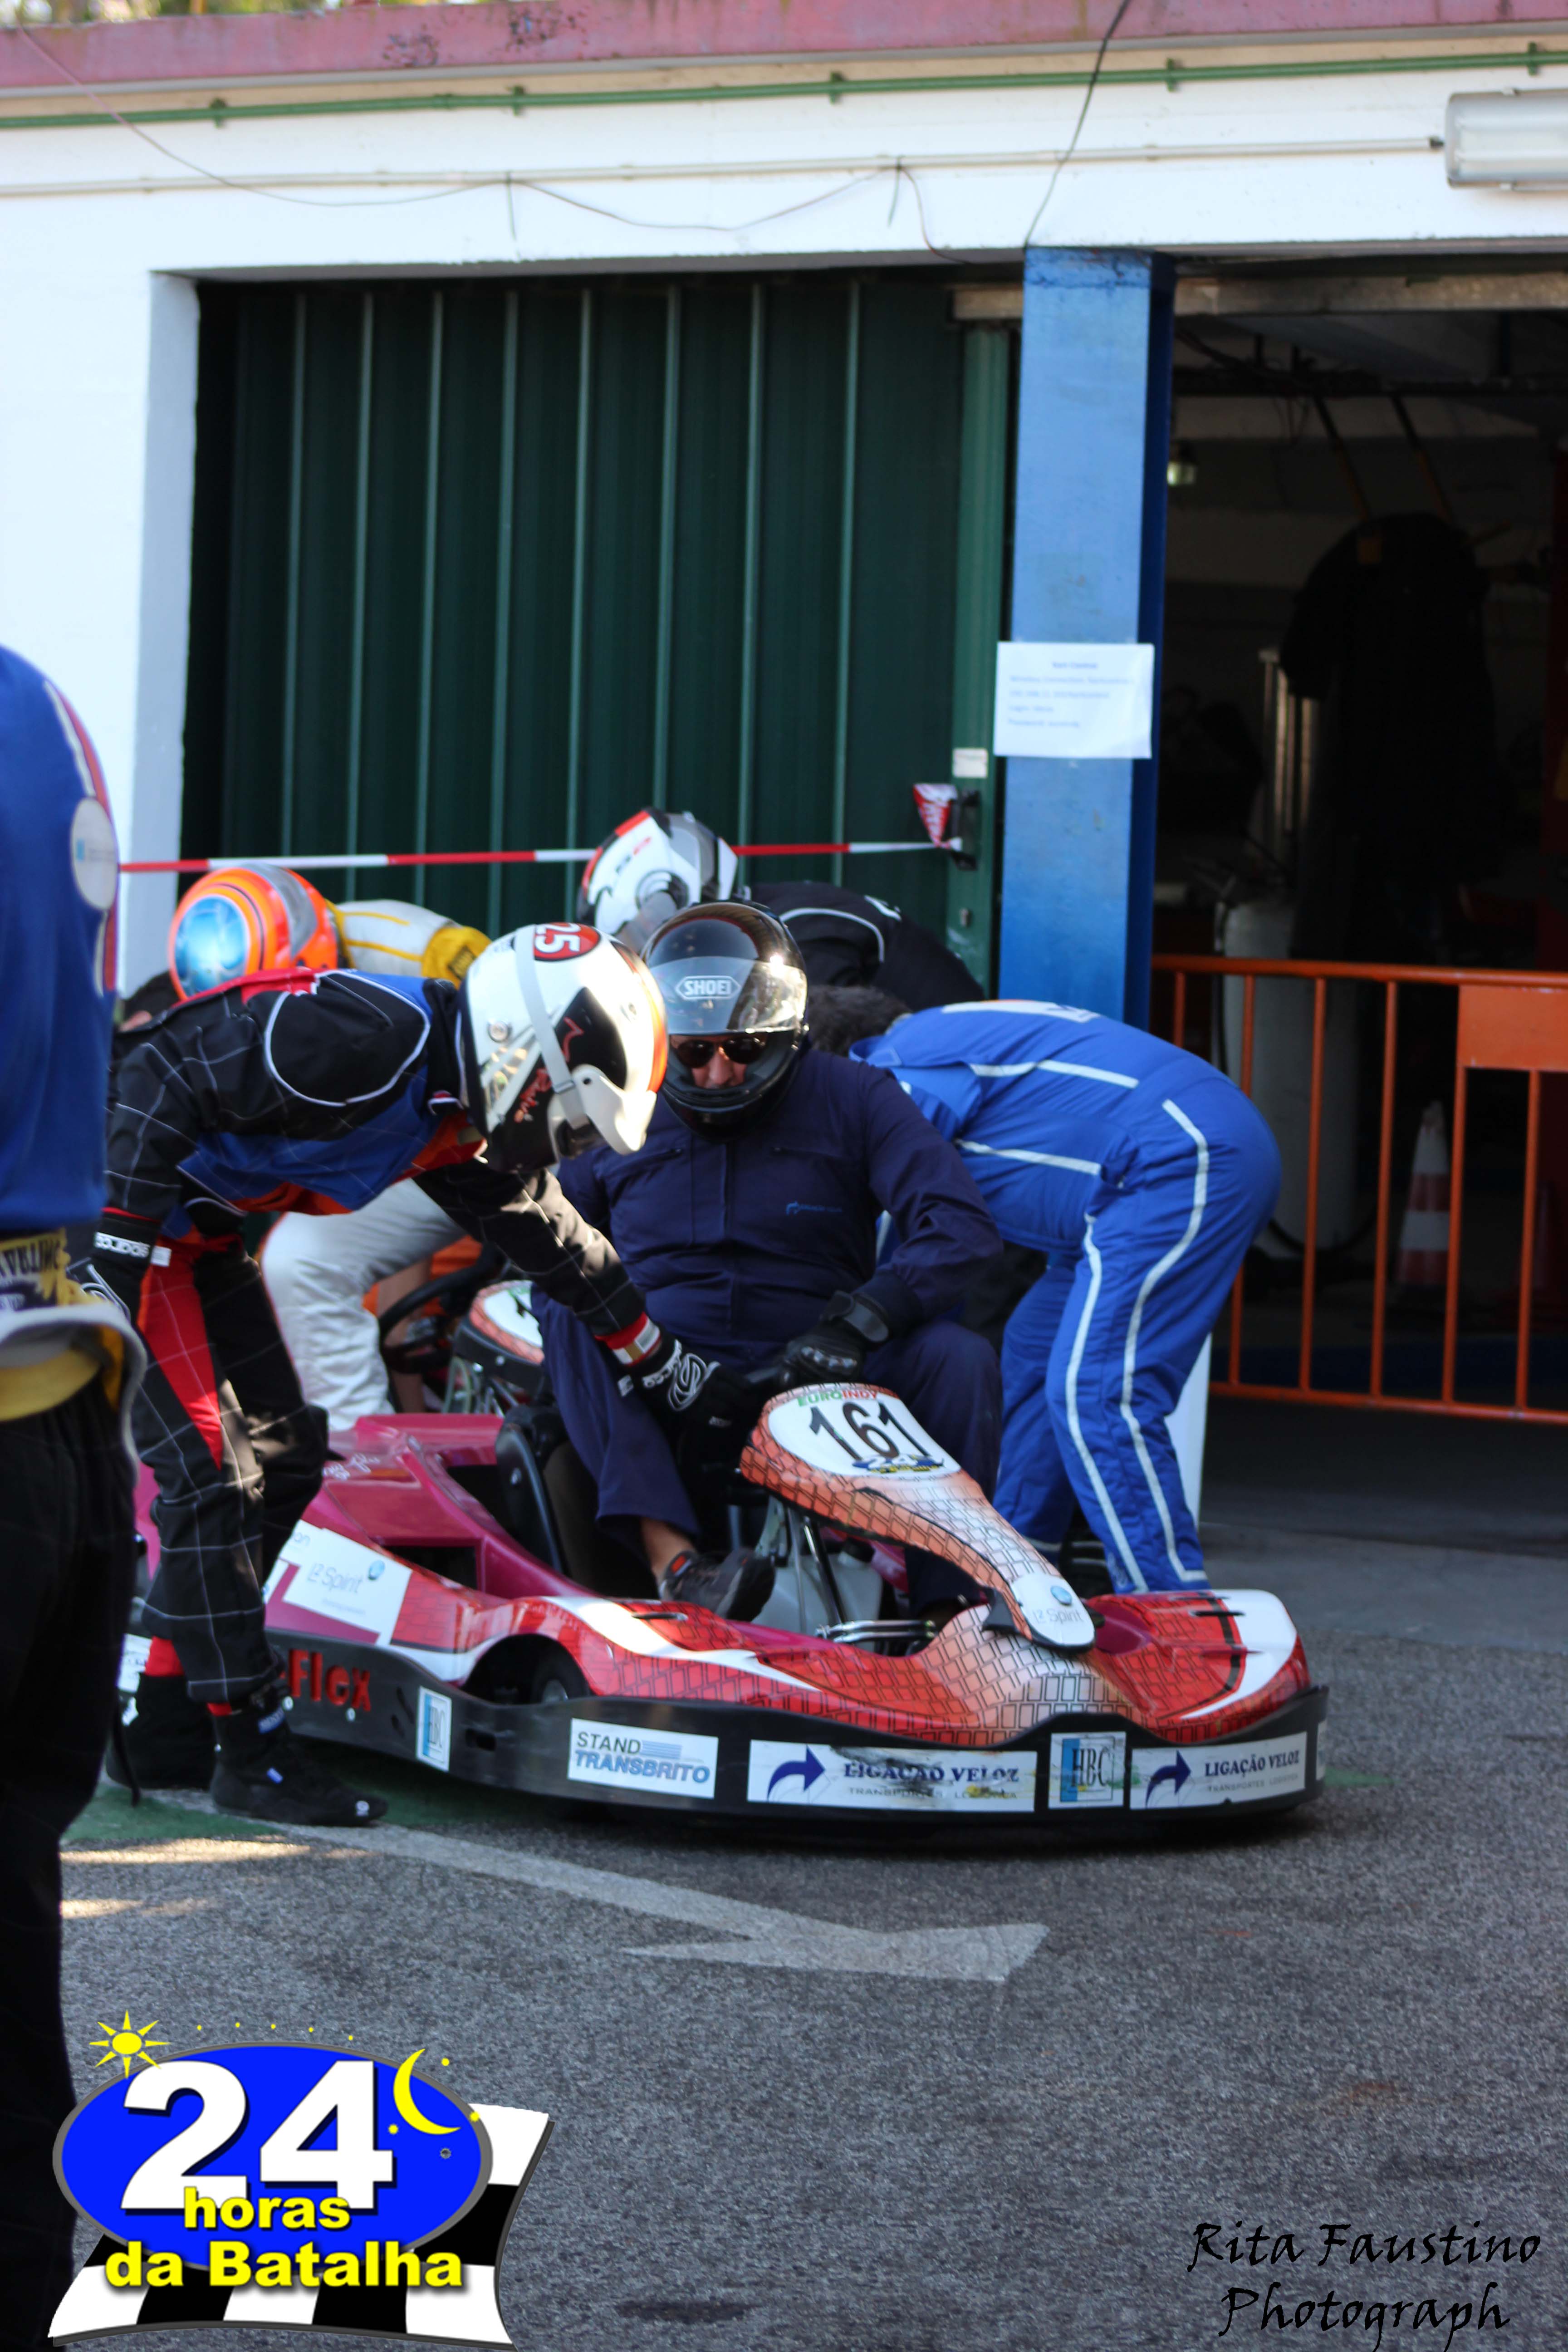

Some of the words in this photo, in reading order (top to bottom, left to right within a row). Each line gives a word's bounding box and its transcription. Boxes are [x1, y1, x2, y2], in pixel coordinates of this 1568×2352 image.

[684, 980, 731, 995] SHOEI
[809, 1401, 932, 1461] 161
[577, 1731, 641, 1755] STAND
[575, 1749, 710, 1784] TRANSBRITO
[1205, 1754, 1266, 1779] LIGAÇÃO
[1269, 1750, 1299, 1769] VELOZ
